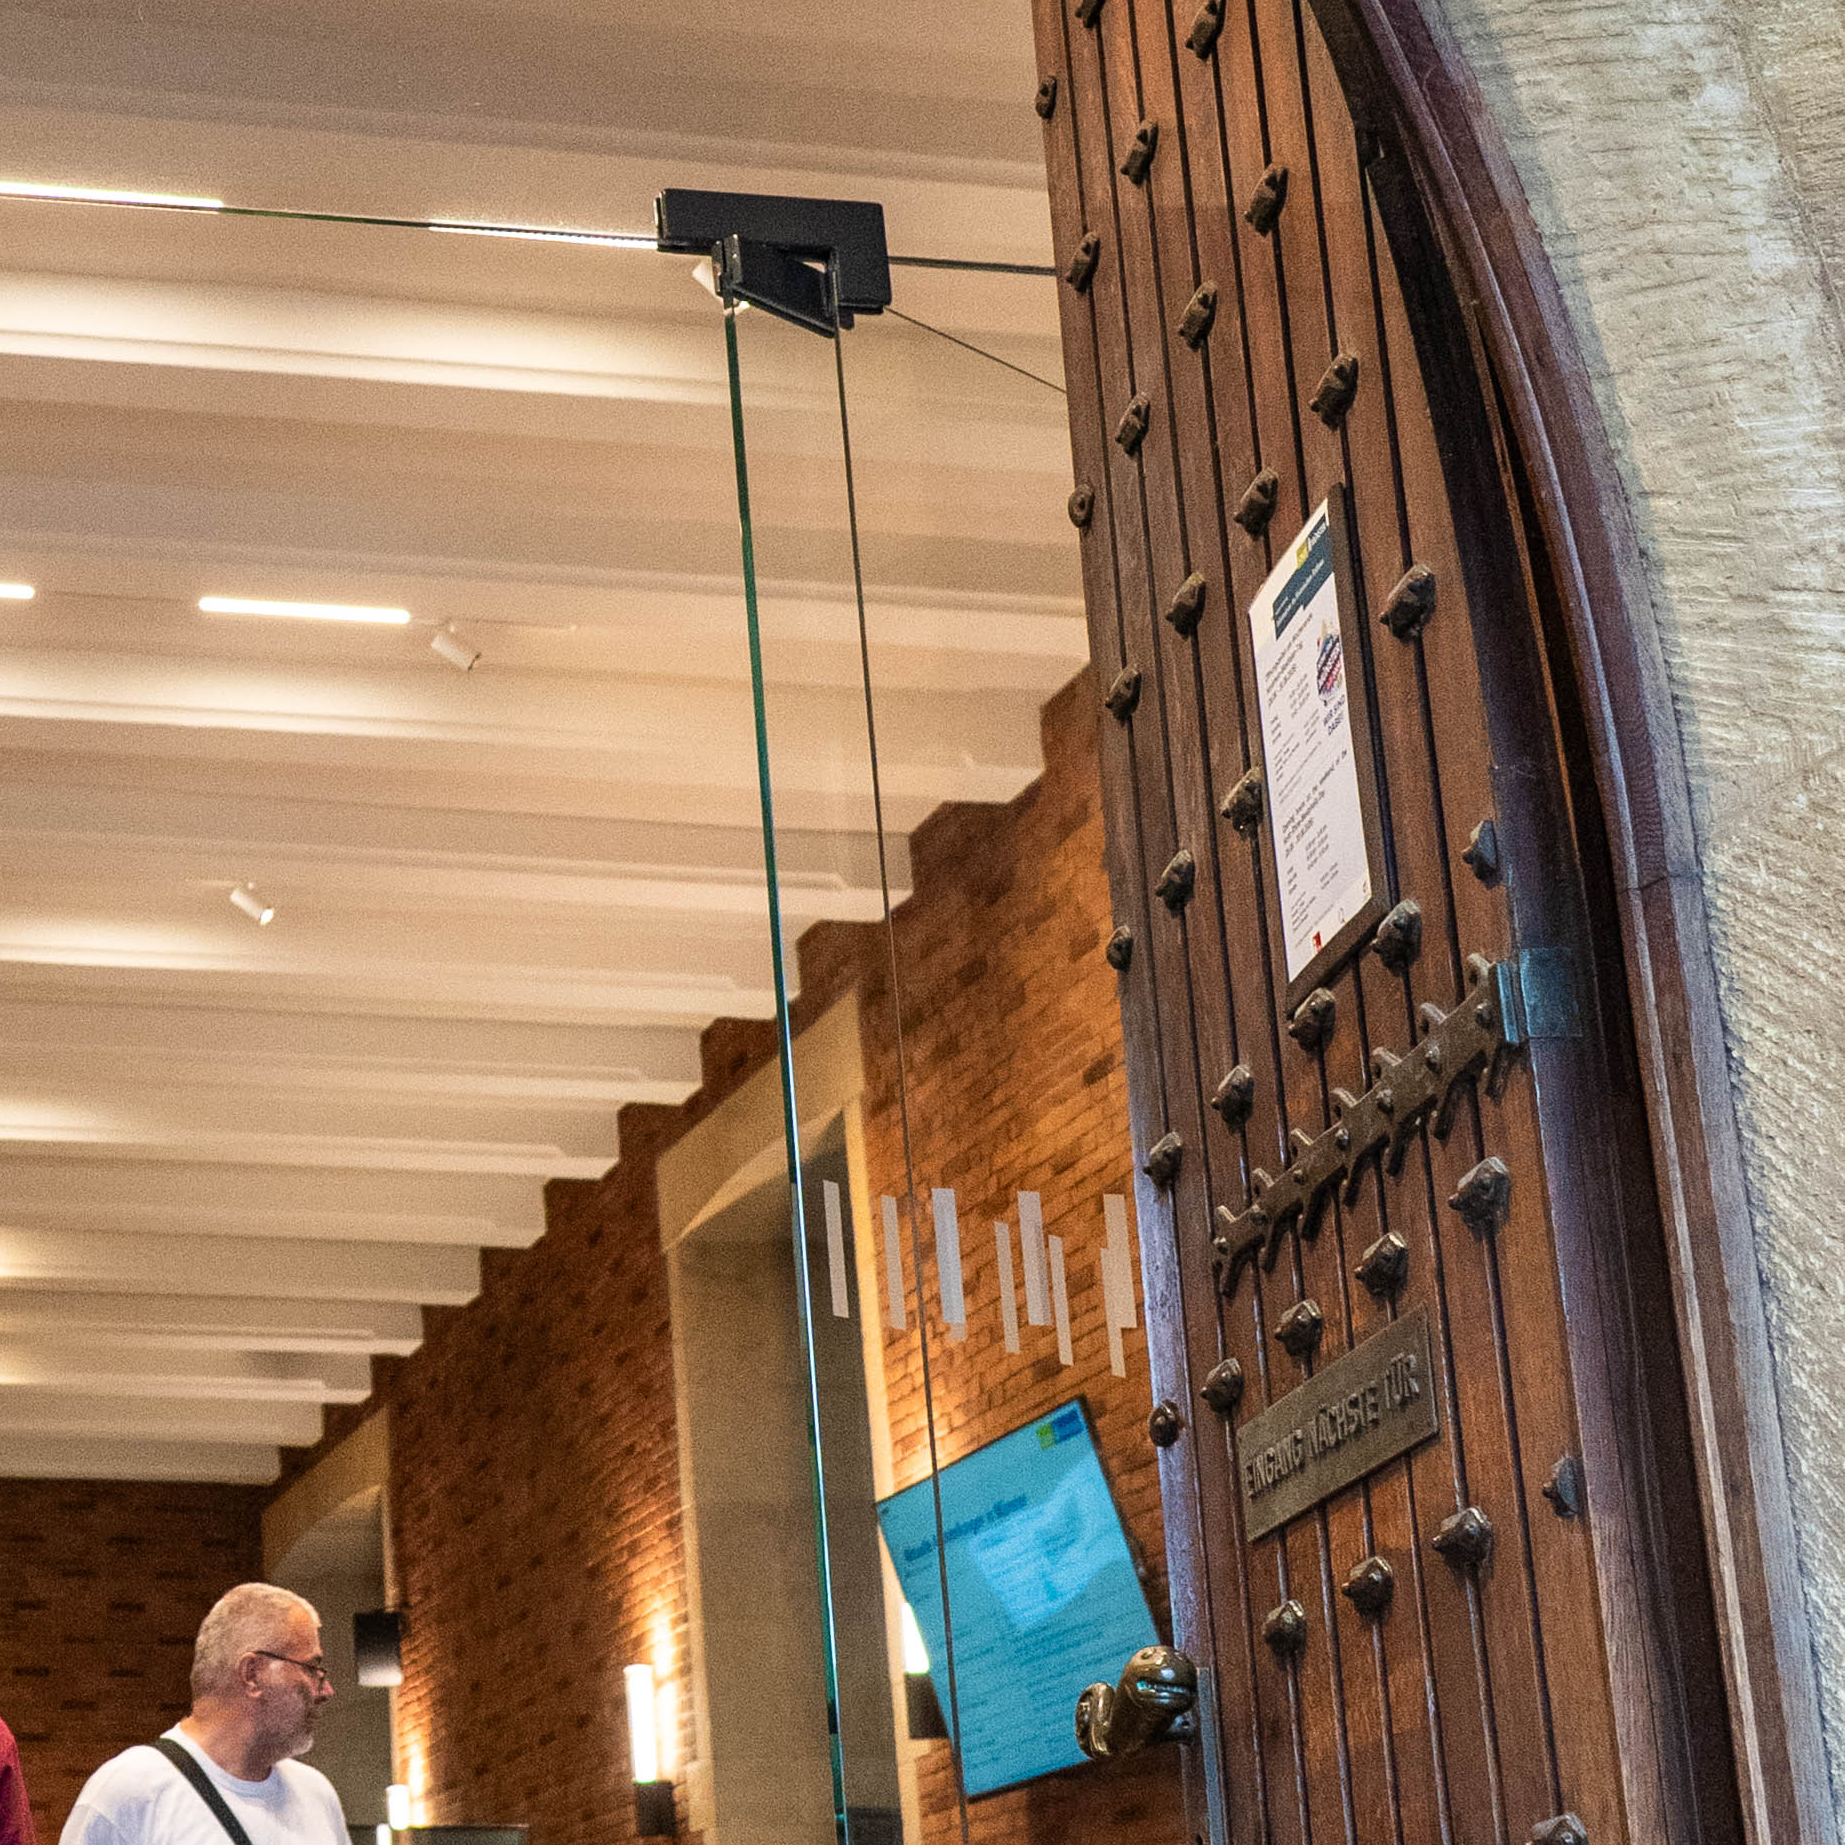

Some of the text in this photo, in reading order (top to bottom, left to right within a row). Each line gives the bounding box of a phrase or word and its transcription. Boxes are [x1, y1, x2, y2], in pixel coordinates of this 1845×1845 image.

[1246, 1352, 1420, 1498] EINGANG NÄCHSTE TÜR
